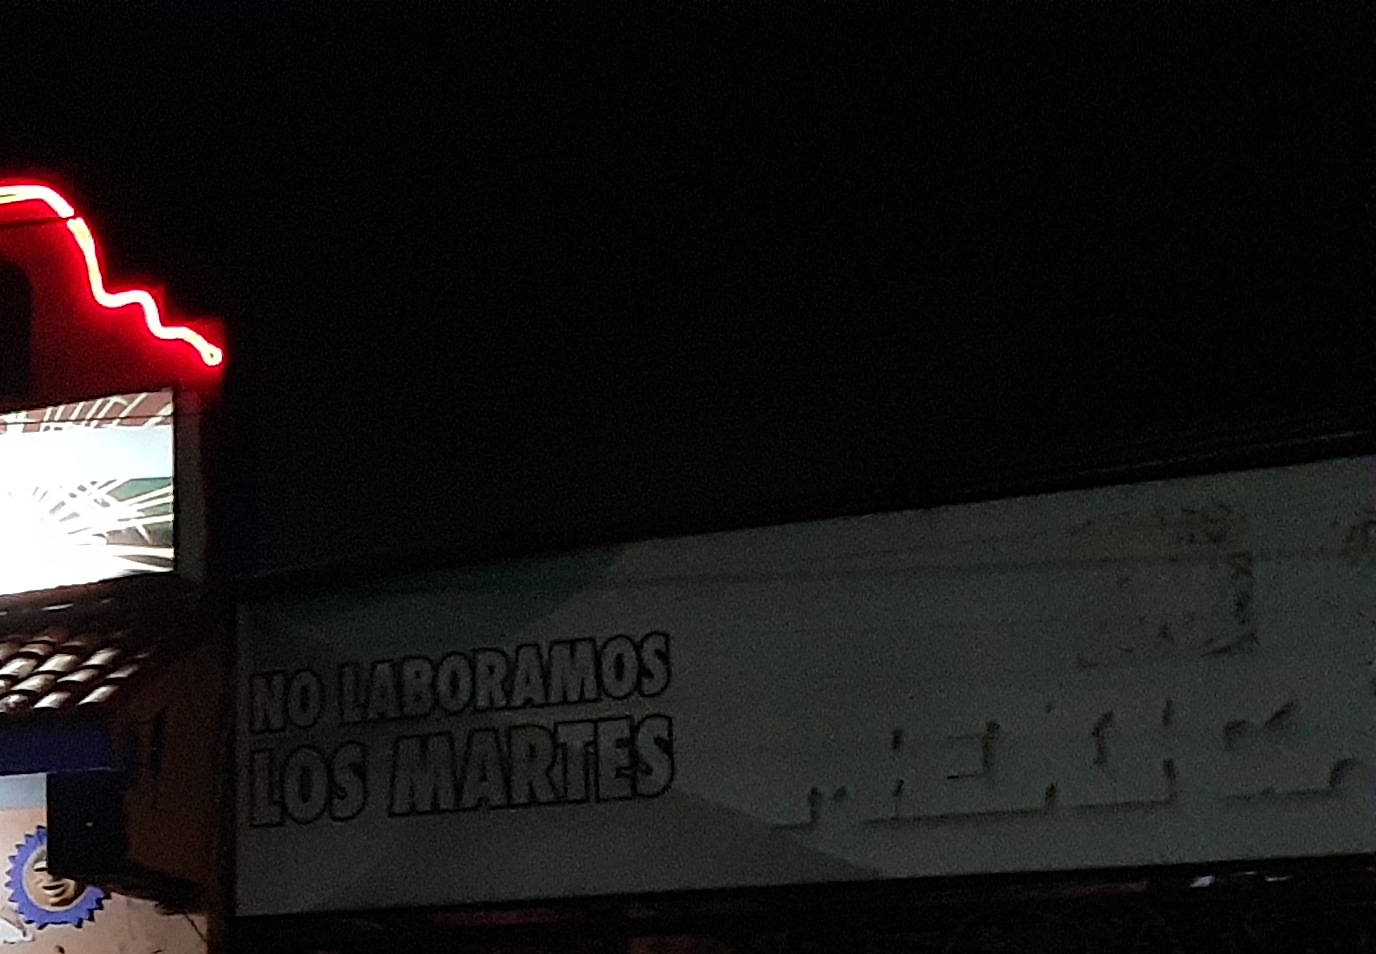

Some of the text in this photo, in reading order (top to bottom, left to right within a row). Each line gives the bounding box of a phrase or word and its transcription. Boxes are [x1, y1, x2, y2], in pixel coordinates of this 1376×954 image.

[249, 631, 672, 735] NO LABORAMOS
[249, 741, 369, 829] LOS
[388, 714, 676, 819] MARTES
